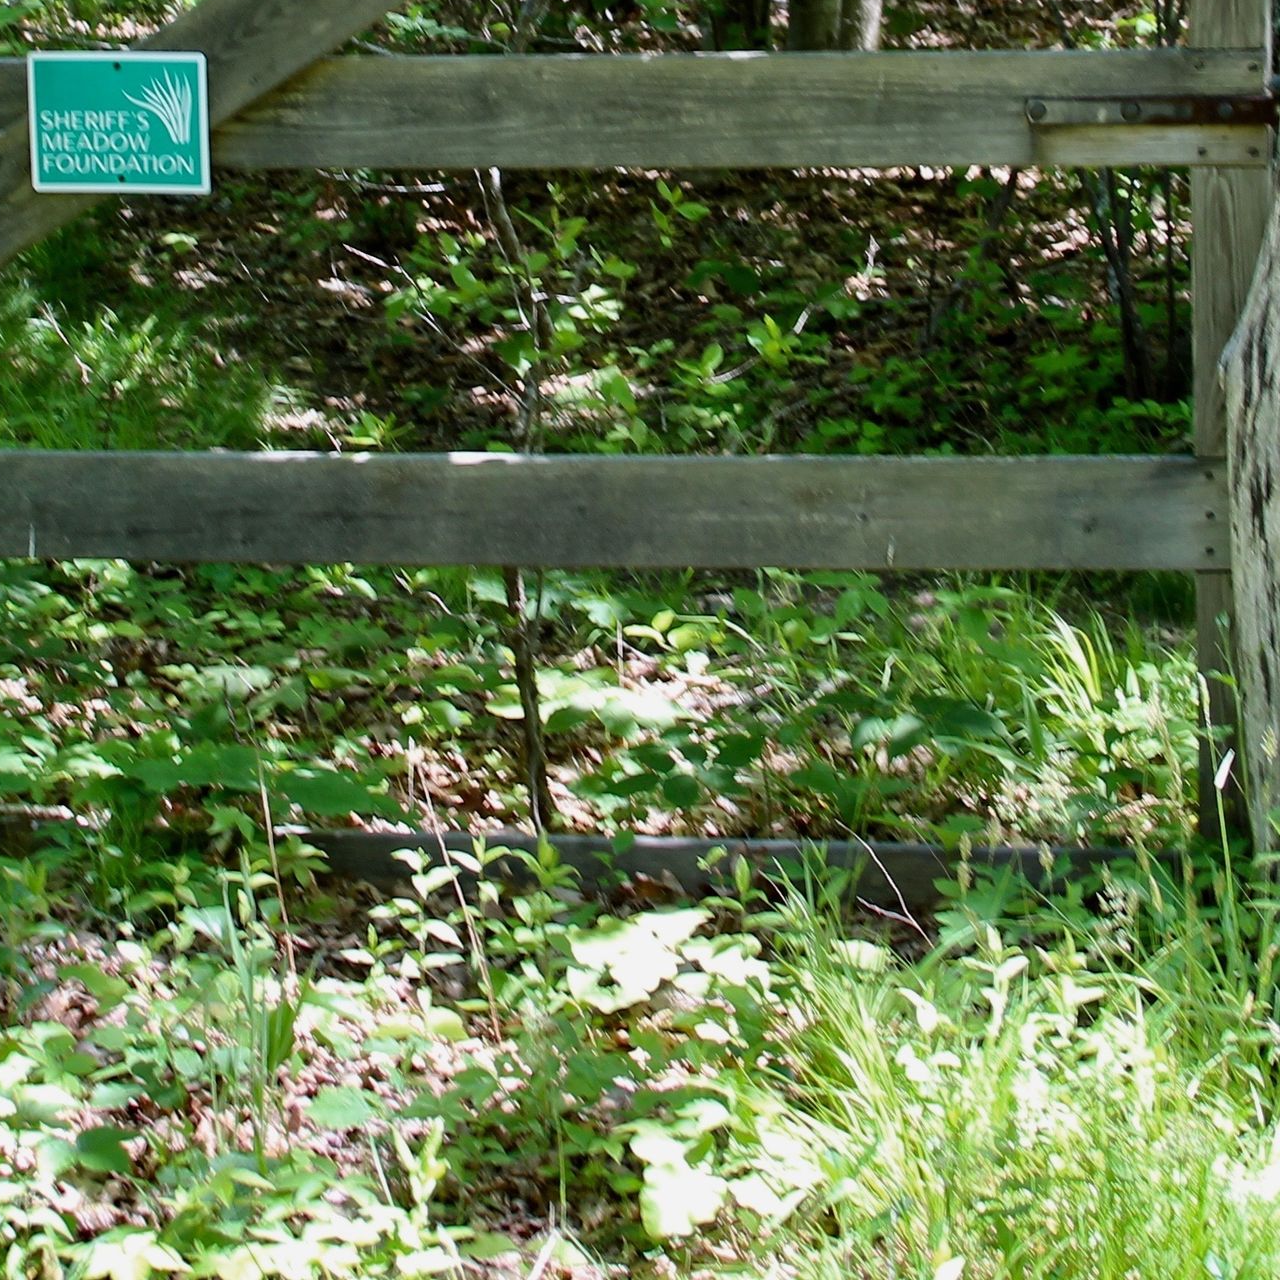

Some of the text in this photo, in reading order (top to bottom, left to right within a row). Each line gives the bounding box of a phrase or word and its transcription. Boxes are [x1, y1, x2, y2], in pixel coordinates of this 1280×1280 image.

[40, 110, 150, 131] SHERIFF'S
[41, 131, 151, 153] MEADOW
[42, 153, 194, 175] FOUNDATION
